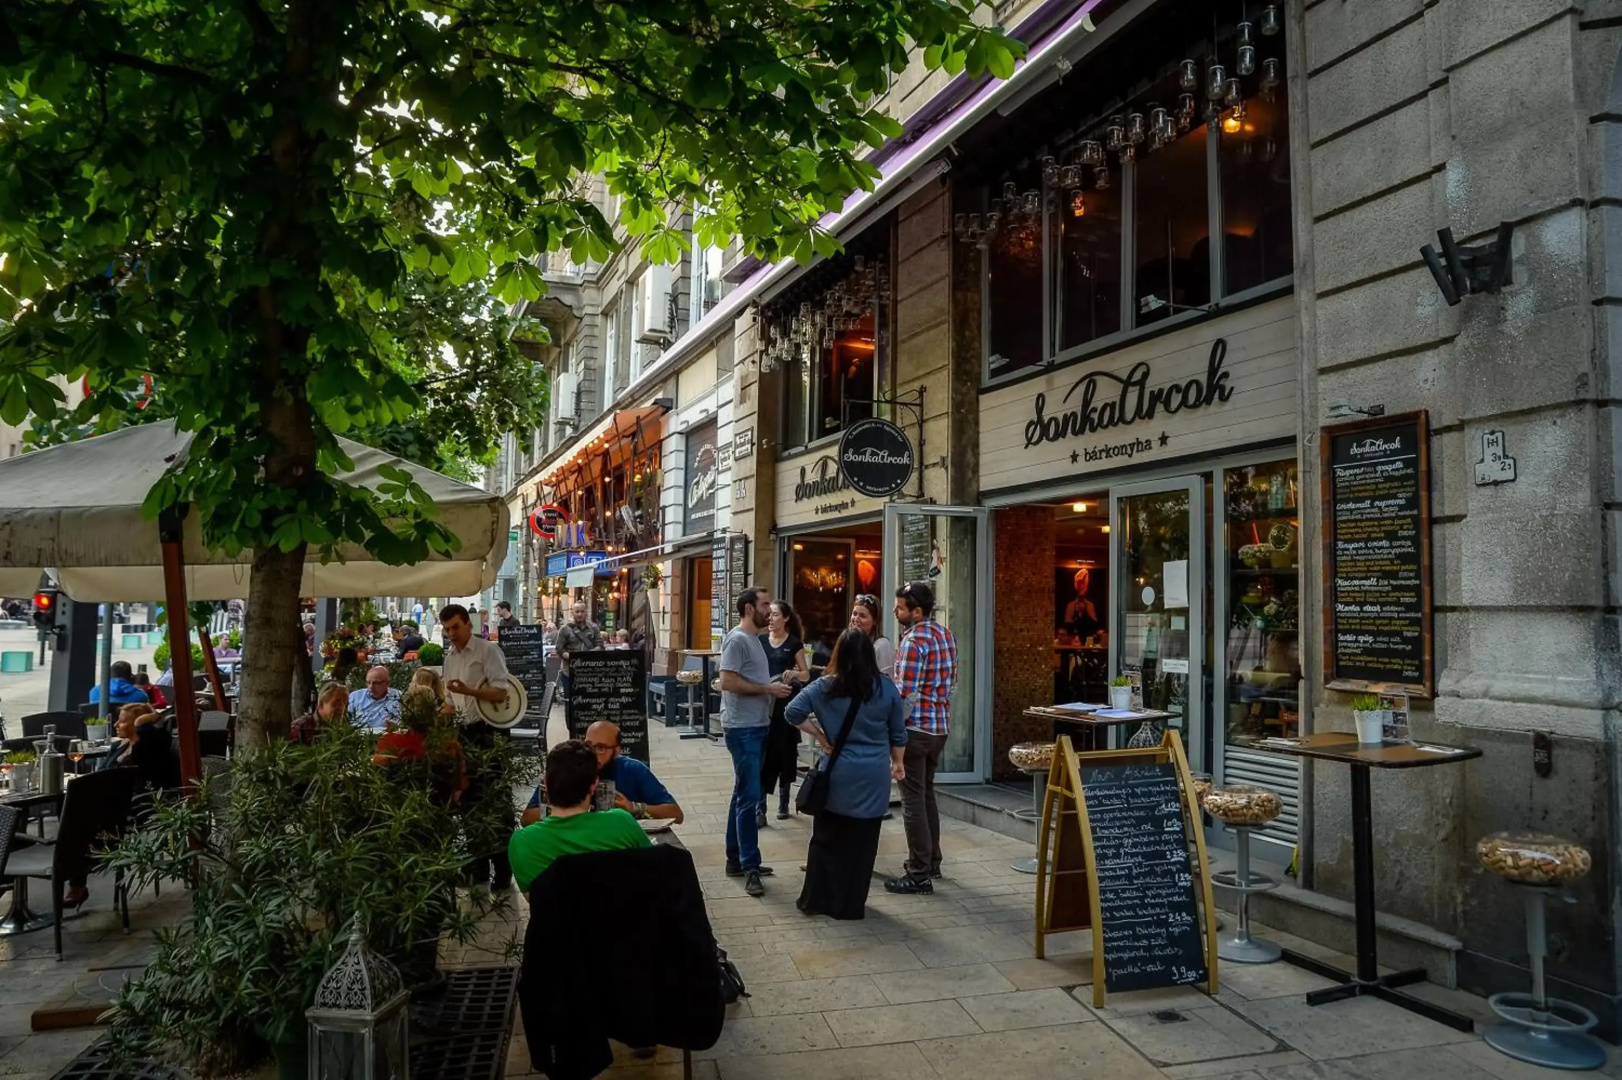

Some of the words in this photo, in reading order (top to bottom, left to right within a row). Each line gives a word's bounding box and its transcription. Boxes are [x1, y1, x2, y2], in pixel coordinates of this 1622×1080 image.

[1024, 337, 1235, 449] SonkaArcok
[843, 447, 911, 465] SonkaArcok
[1083, 436, 1153, 463] bárkonyha
[1350, 436, 1402, 455] SonkaArcok
